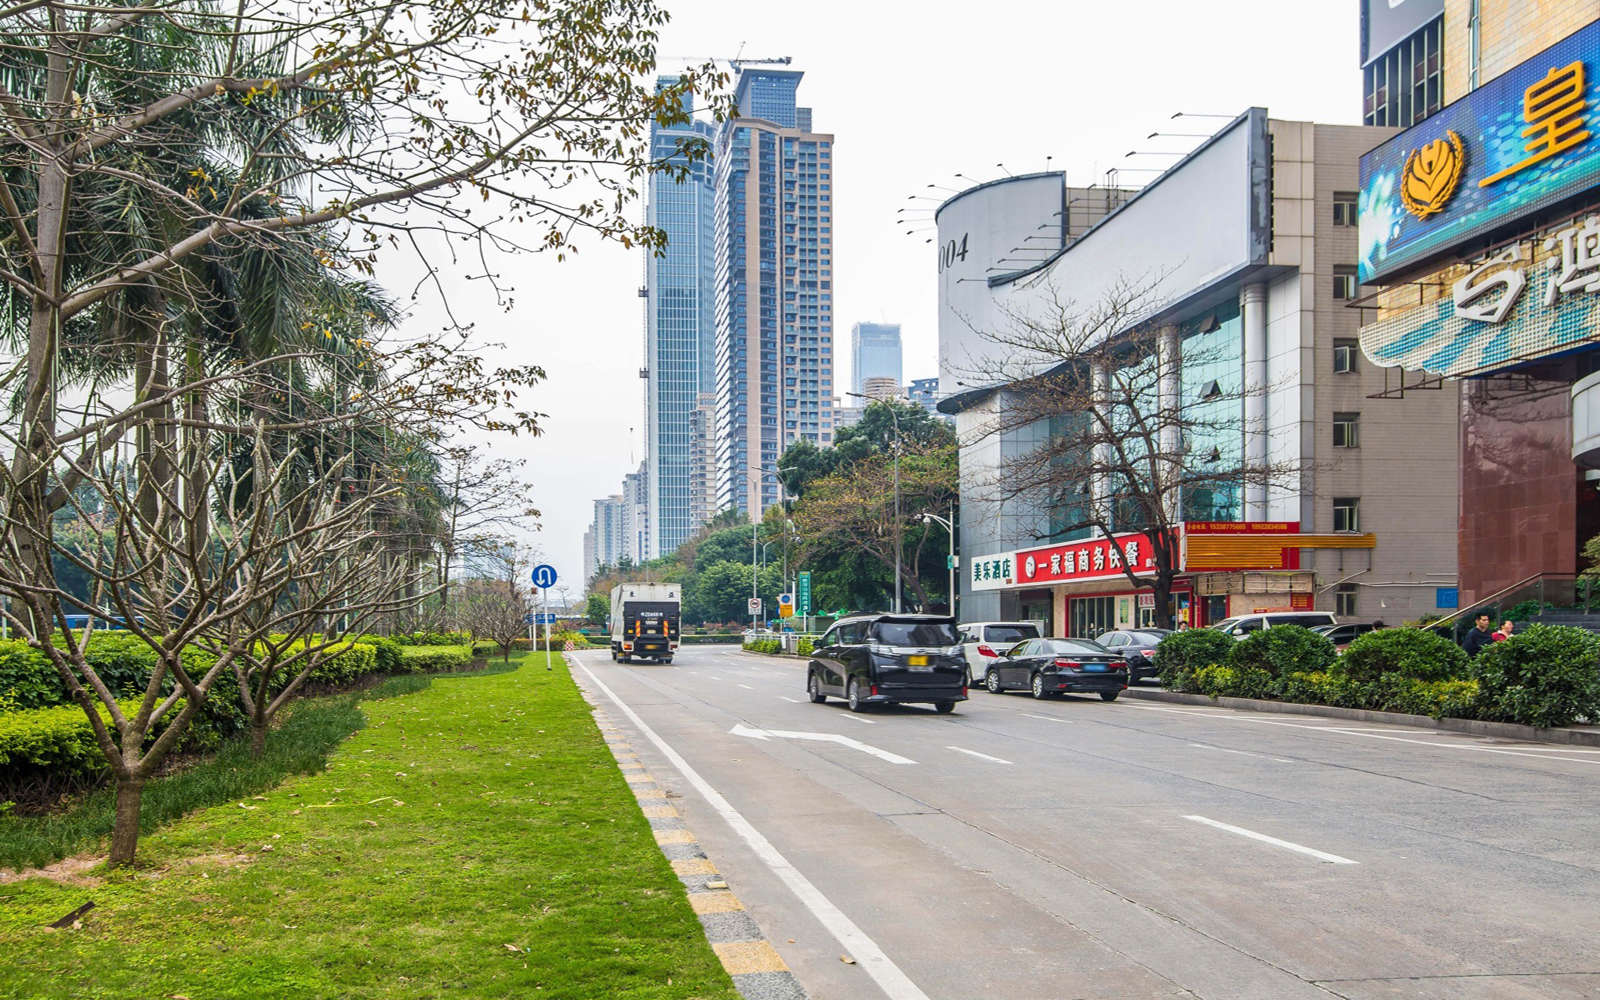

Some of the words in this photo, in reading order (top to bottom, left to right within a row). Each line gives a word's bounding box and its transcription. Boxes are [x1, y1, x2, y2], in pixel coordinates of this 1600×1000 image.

[1478, 60, 1592, 189] 皇
[974, 558, 1011, 582] 美乐酒店
[1038, 541, 1138, 575] 一家福商务快餐
